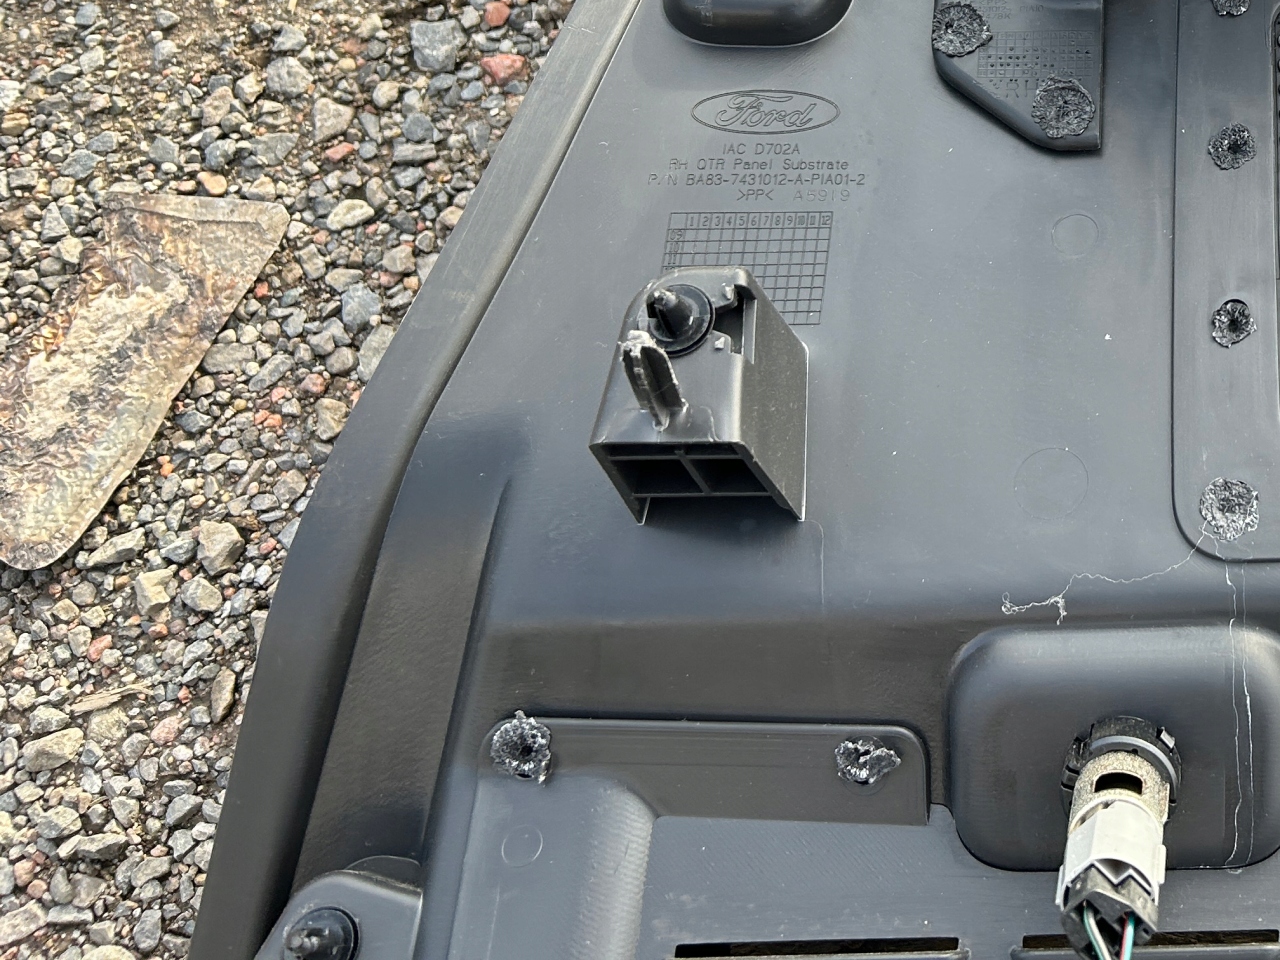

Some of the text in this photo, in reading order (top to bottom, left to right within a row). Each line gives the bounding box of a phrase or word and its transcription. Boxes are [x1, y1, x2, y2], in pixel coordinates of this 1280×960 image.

[714, 93, 817, 128] Ford
[722, 143, 801, 155] IAC D702A
[669, 158, 849, 171] RH QTR Panel Substrate
